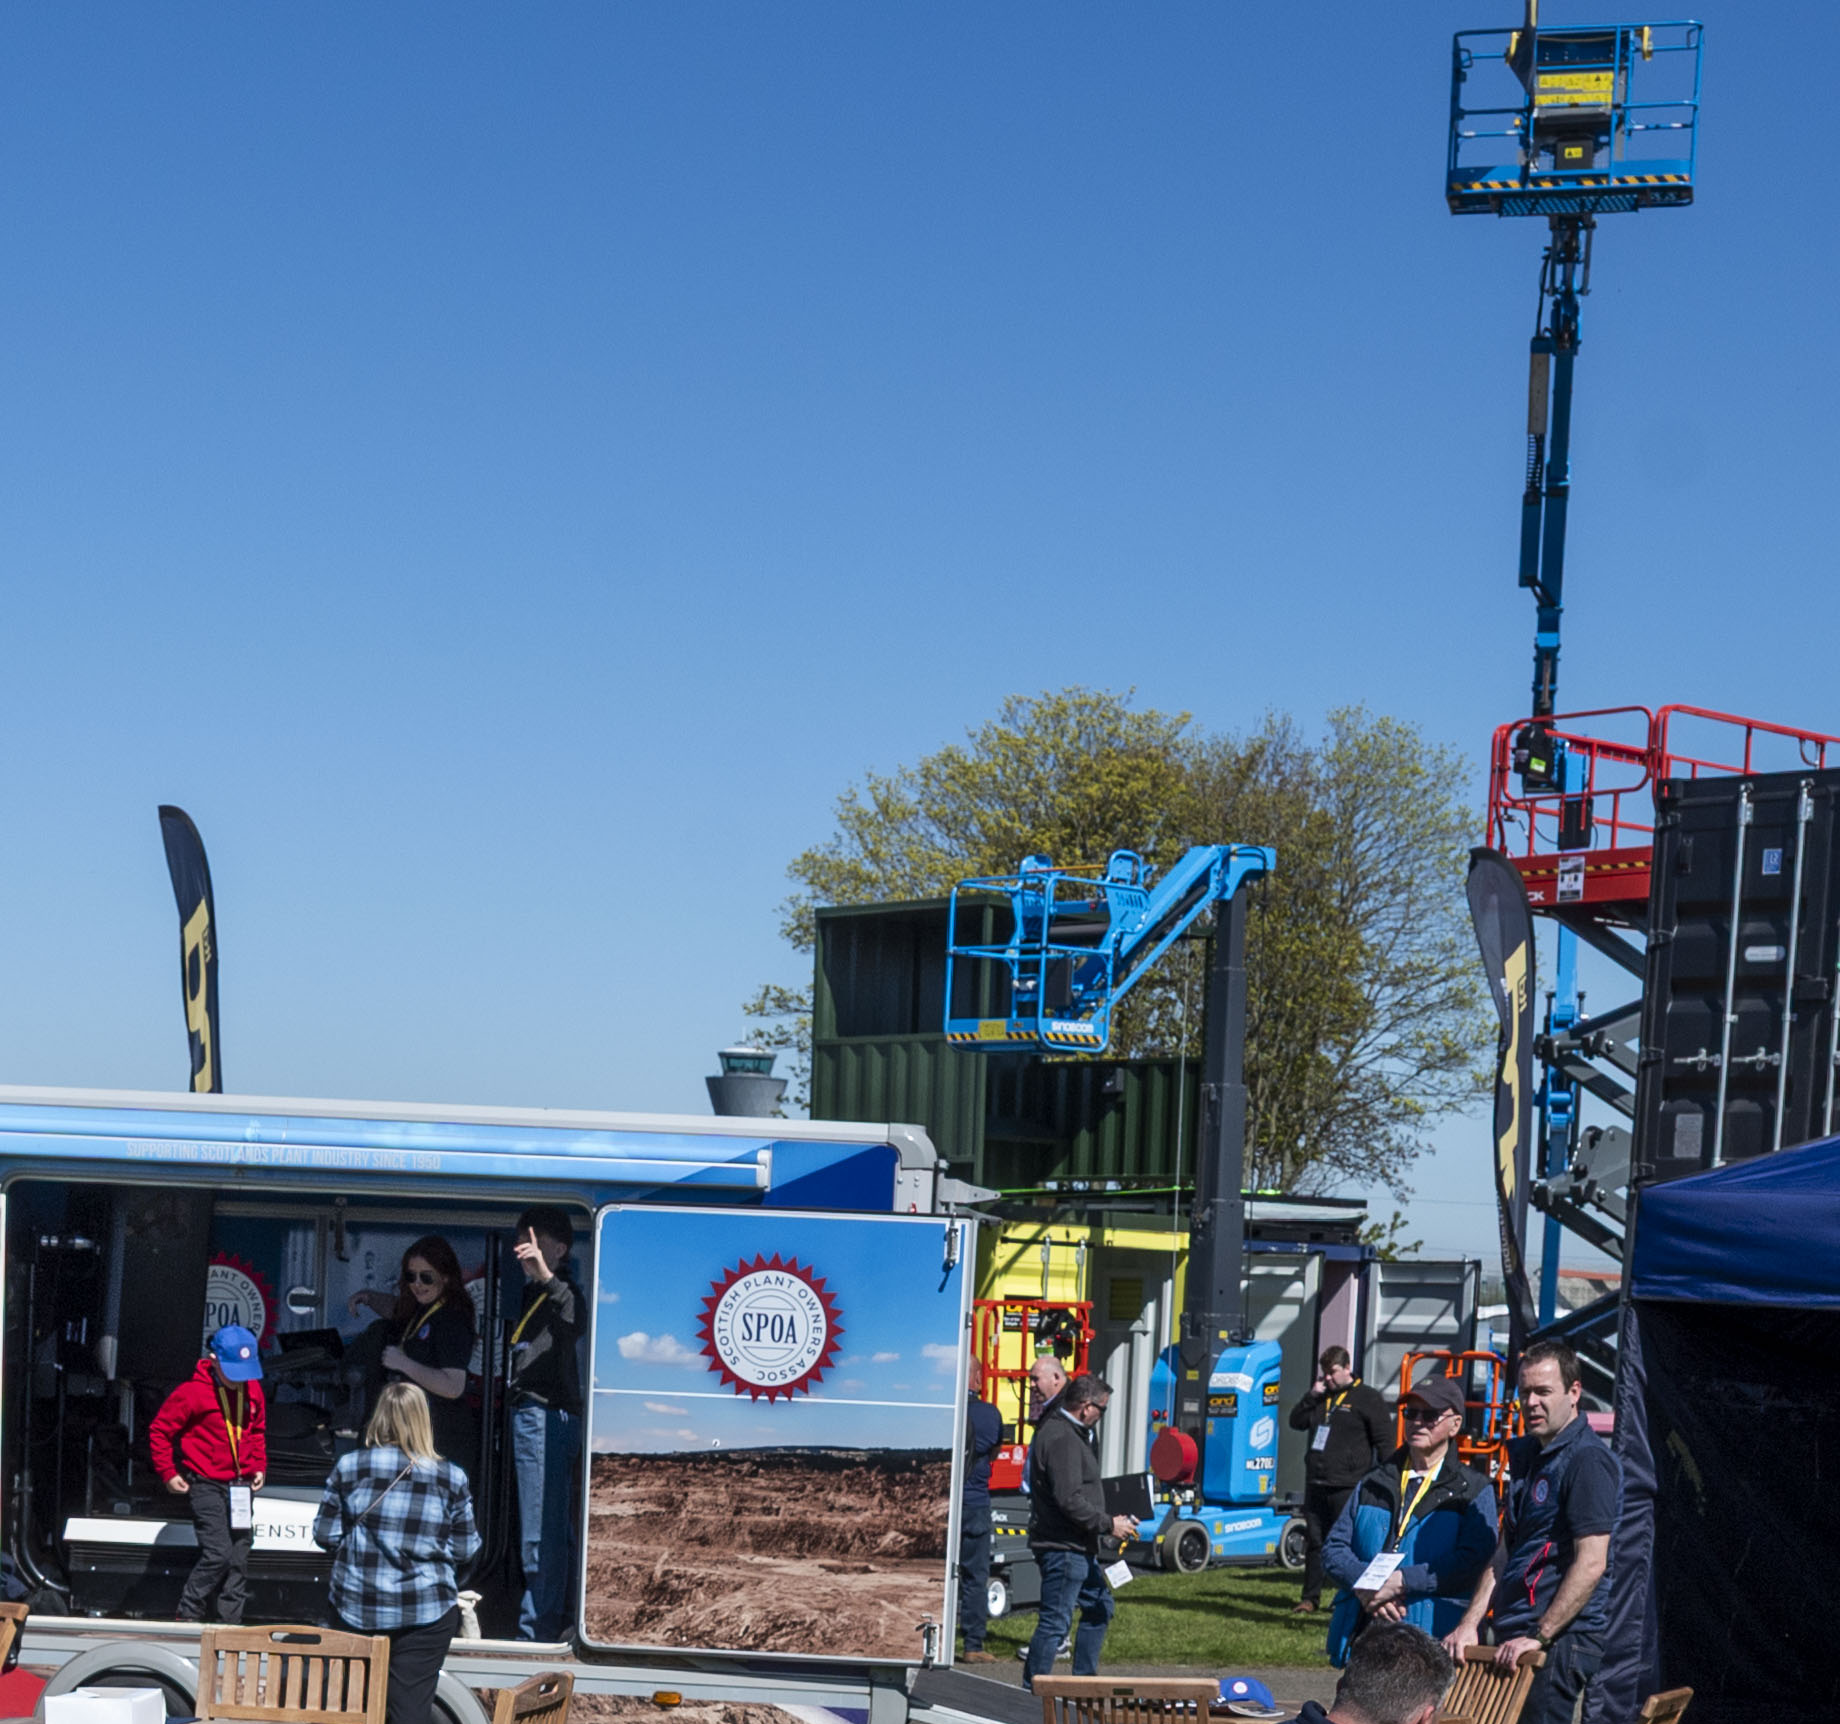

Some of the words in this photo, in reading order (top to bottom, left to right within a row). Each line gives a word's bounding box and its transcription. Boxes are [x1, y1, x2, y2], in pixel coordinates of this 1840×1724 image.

[127, 1142, 198, 1160] SUPPORTING
[201, 1145, 267, 1163] SCOTLANDS
[272, 1147, 308, 1164] PLANT
[312, 1149, 369, 1167] INDUSTRY
[372, 1152, 407, 1168] SINCE
[412, 1153, 441, 1170] 1950
[205, 1302, 240, 1329] POA
[240, 1280, 262, 1339] OWNER
[718, 1290, 741, 1366] SCOTTISH
[743, 1275, 795, 1291] PLANT
[797, 1288, 823, 1357] OWNERS
[742, 1312, 798, 1344] SPOA
[254, 1523, 311, 1539] ENST
